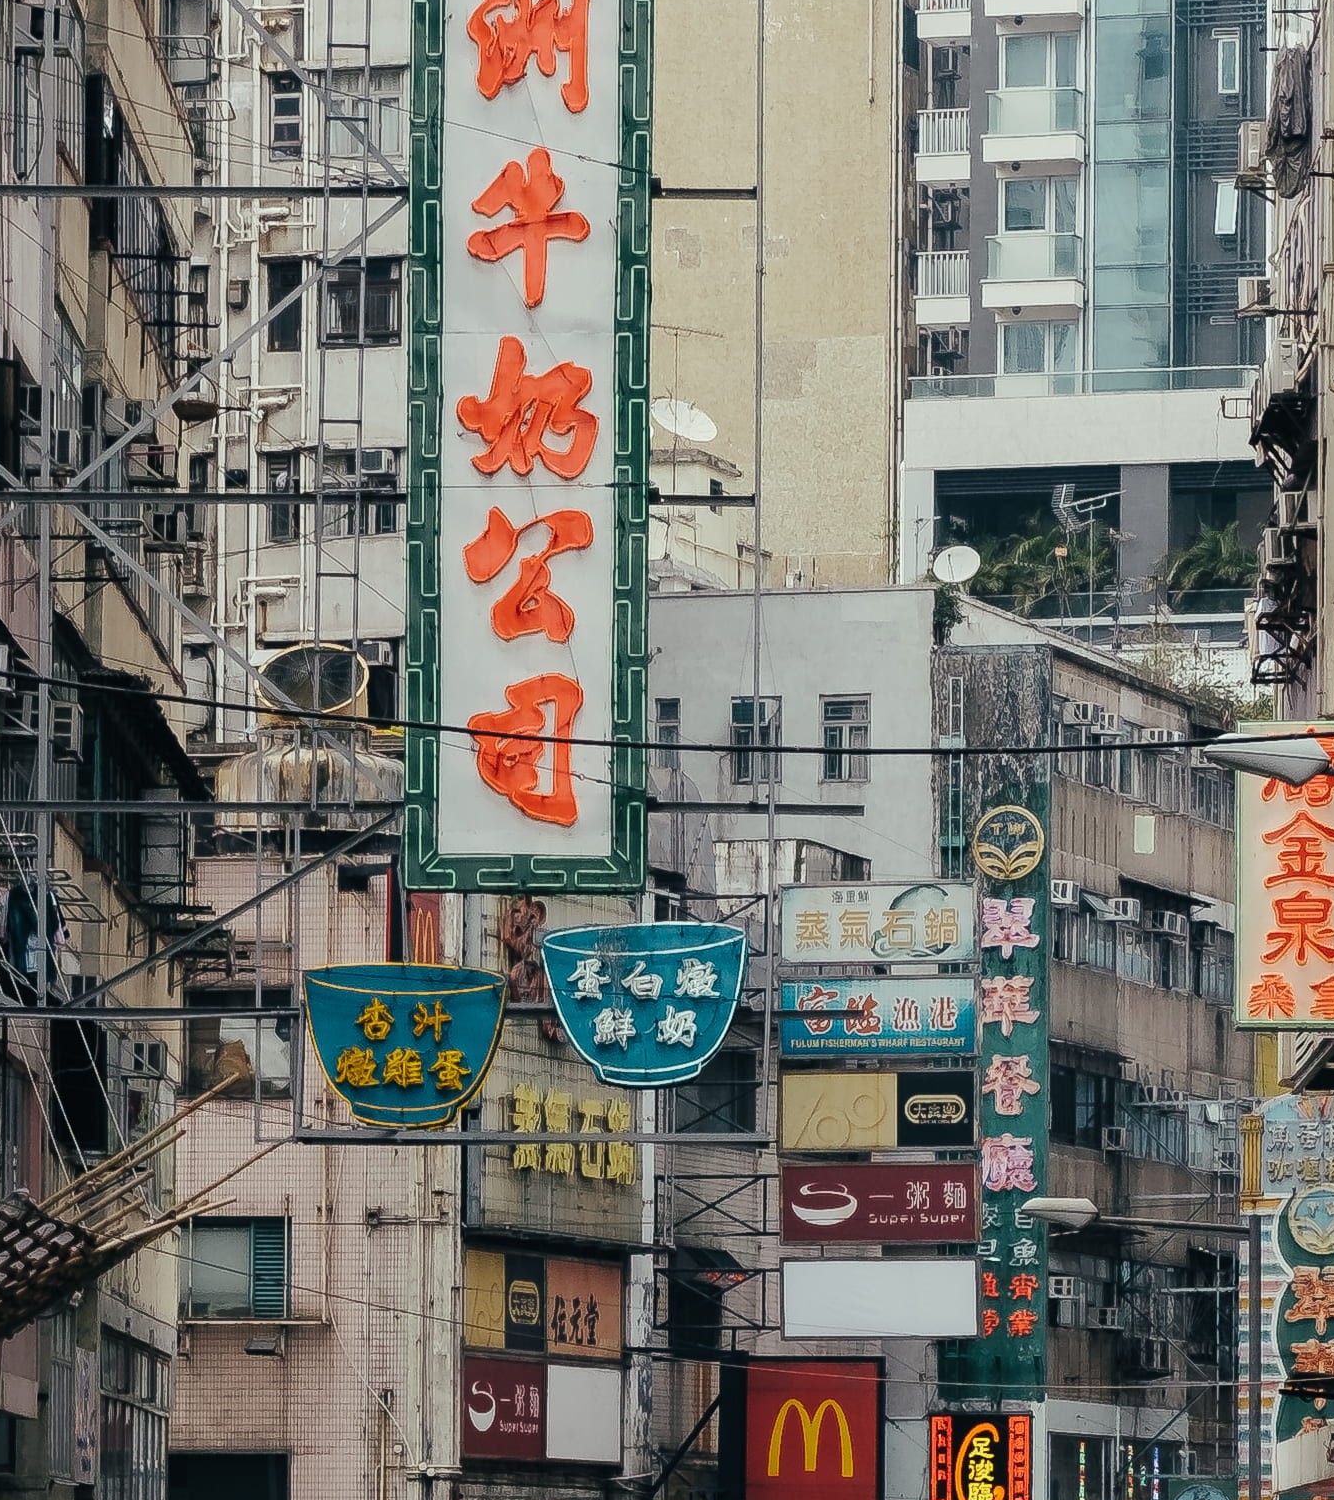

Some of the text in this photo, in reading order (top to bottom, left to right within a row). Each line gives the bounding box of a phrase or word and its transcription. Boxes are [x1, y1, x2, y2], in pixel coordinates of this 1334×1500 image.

[796, 908, 959, 949] 蒸氣石鍋
[355, 998, 452, 1042] 杏汁
[593, 1007, 698, 1050] 鮮奶
[981, 898, 1041, 1192] 翠華餐廳
[869, 1213, 966, 1225] Super Super
